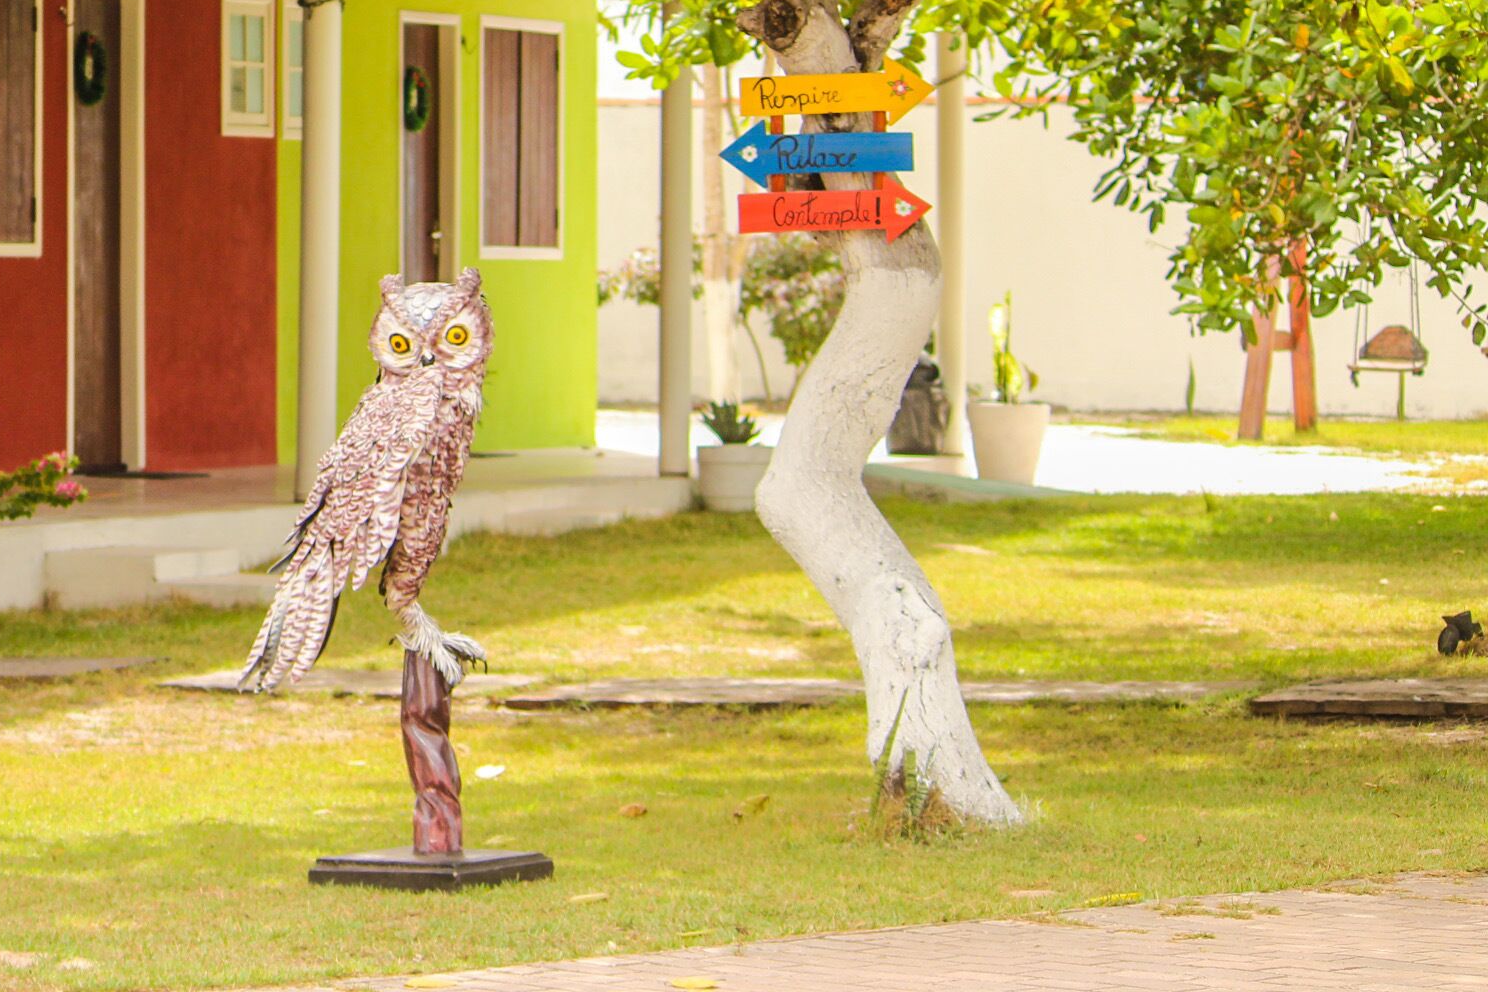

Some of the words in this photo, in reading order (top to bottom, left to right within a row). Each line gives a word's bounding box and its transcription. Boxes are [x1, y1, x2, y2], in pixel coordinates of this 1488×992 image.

[752, 76, 843, 111] Respire
[770, 134, 858, 171] Relaxe
[773, 191, 882, 227] Contemple!
